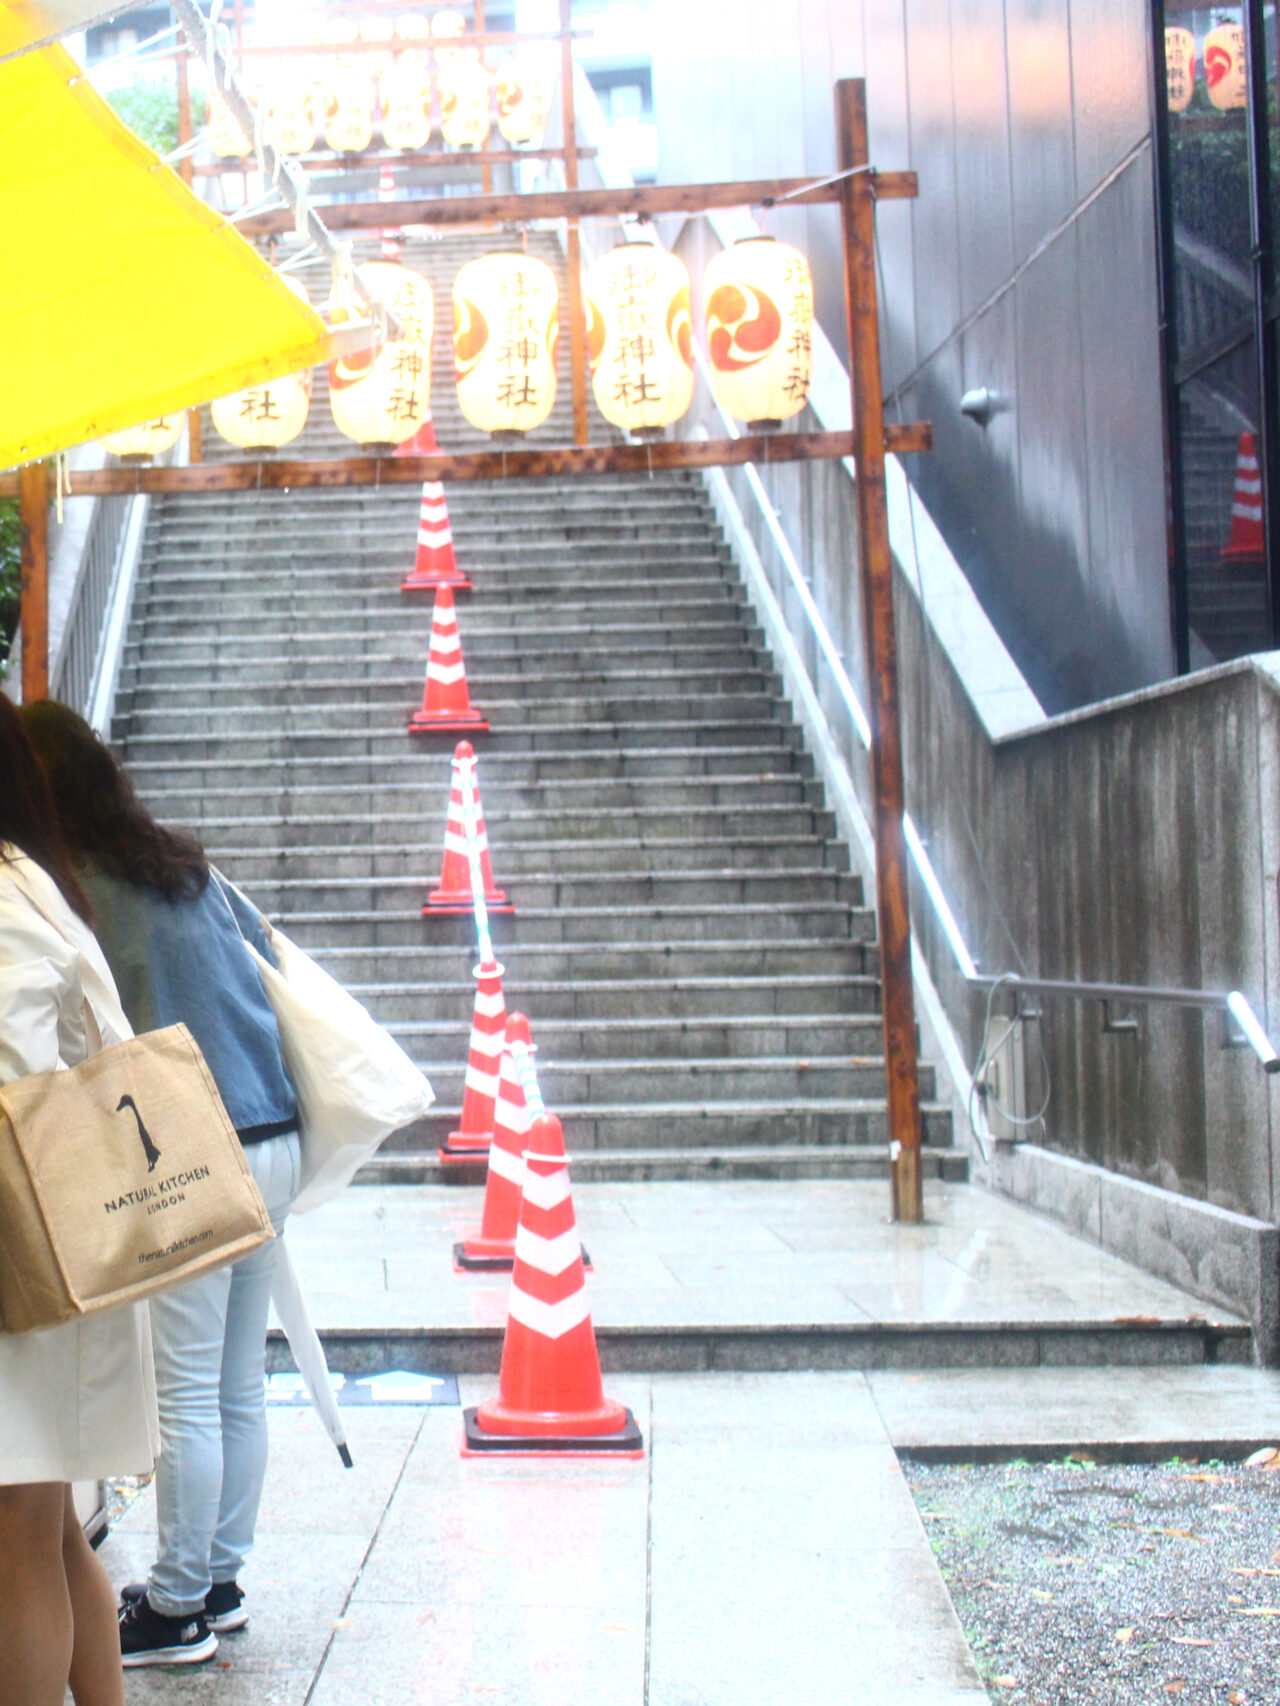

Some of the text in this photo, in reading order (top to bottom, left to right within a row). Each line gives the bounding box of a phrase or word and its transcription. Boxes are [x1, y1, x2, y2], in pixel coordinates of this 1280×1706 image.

[103, 1164, 211, 1214] NATURAL KITCHEN
[147, 1192, 186, 1216] LONDON
